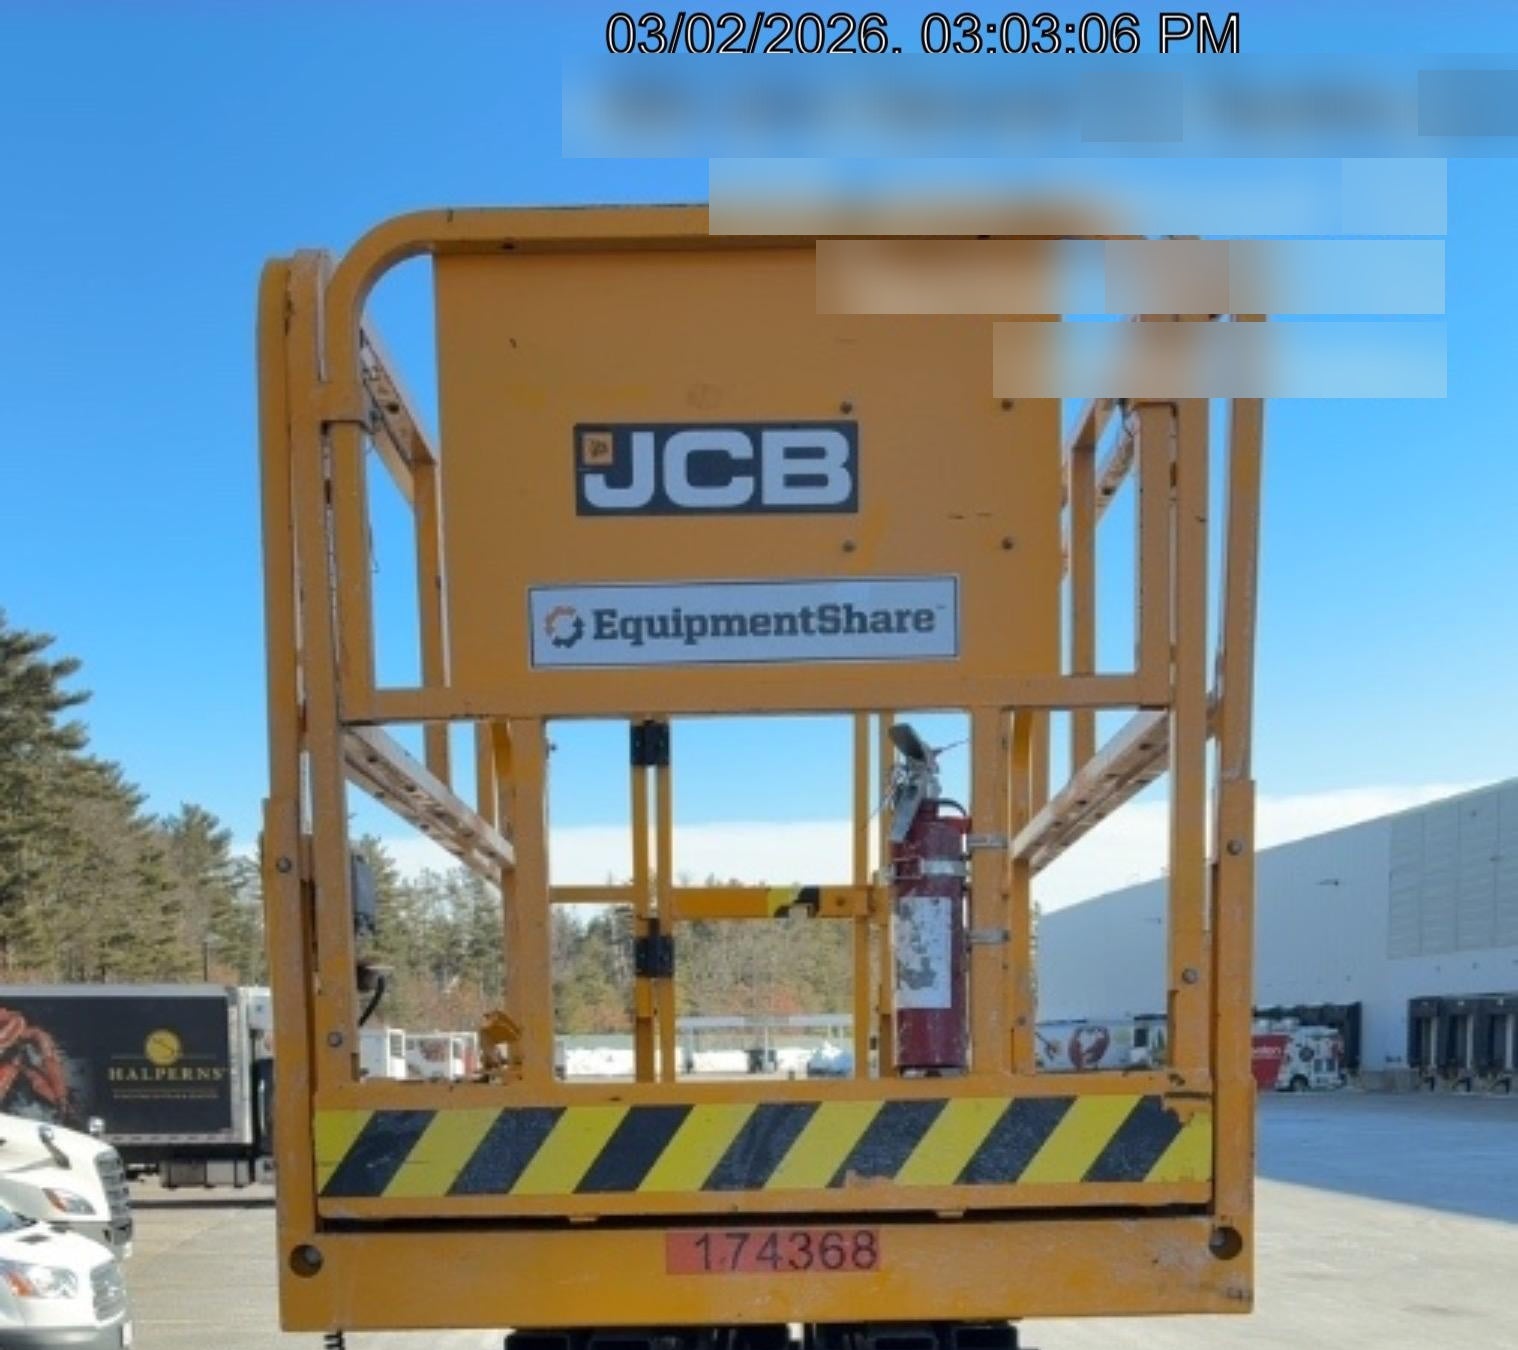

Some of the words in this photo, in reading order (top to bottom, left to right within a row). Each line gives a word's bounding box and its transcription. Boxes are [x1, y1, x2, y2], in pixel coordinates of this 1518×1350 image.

[583, 429, 853, 509] JCB
[592, 602, 936, 648] EquipmentShare
[694, 1230, 879, 1271] 174368
